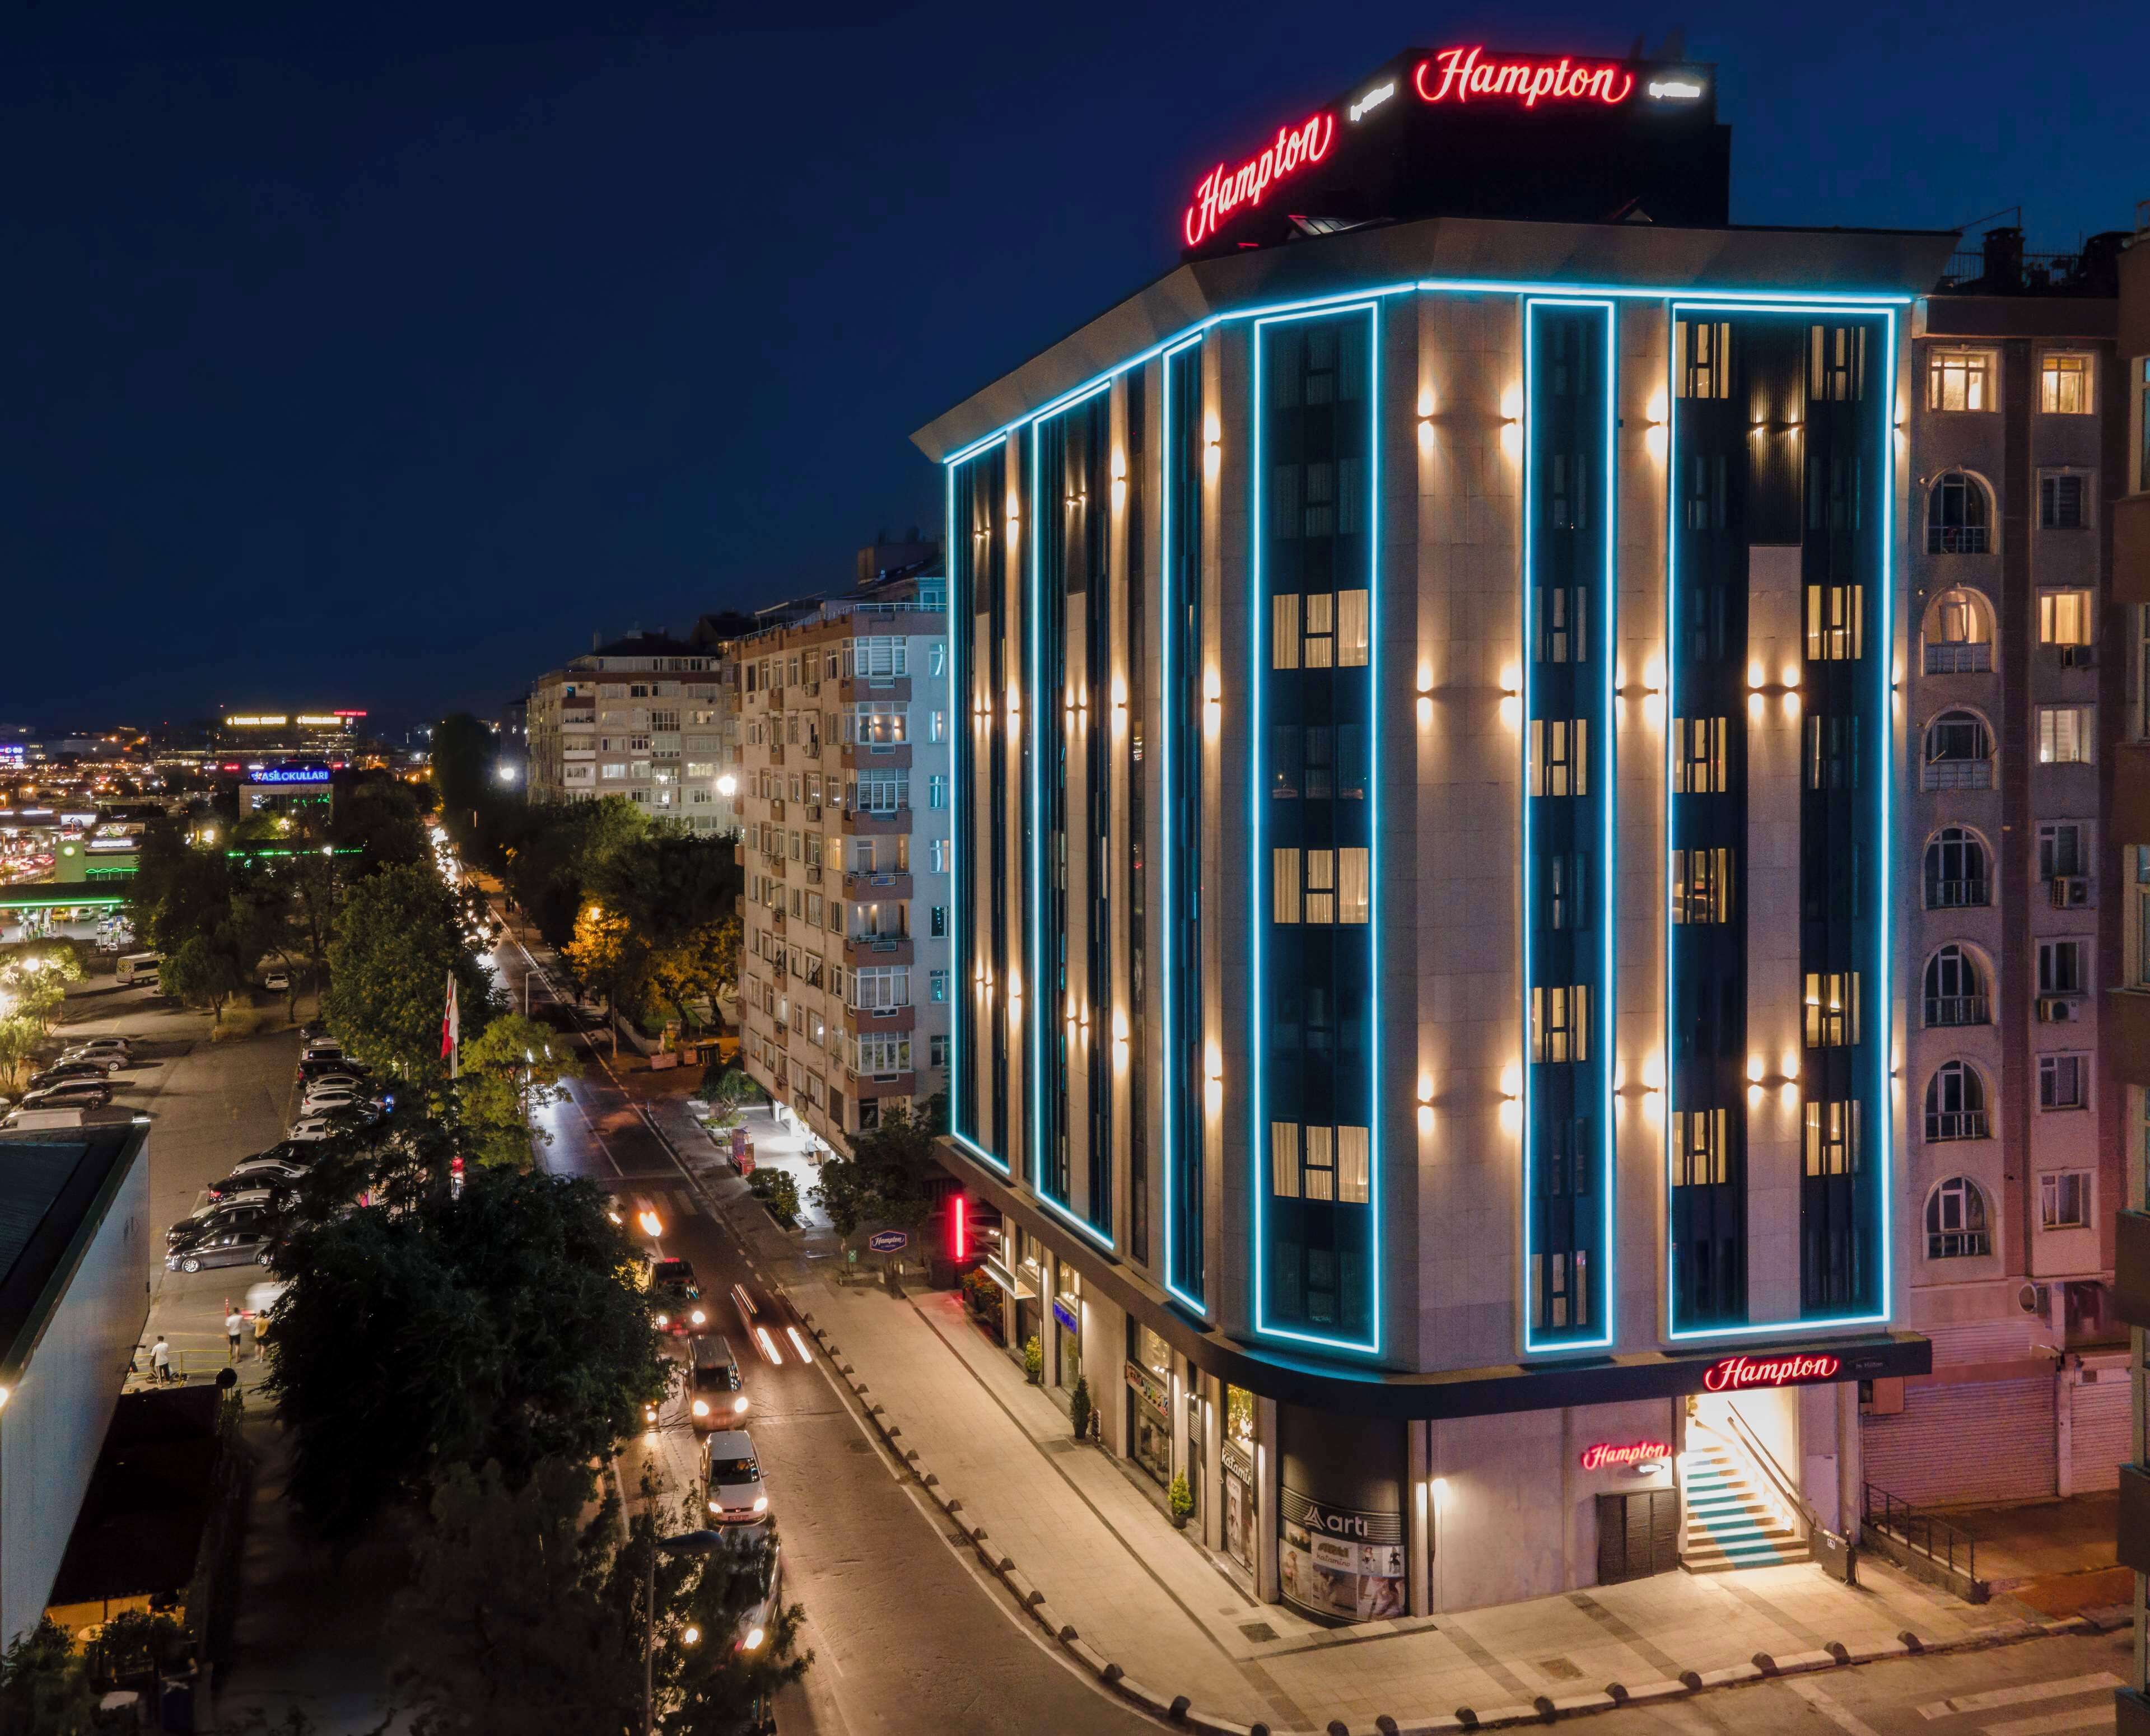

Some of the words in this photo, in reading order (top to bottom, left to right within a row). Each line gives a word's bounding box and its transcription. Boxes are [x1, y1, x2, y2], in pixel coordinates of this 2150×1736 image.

[1416, 46, 1632, 106] Hampton
[1186, 114, 1333, 245] Hampton
[871, 1236, 904, 1246] Hampton
[1705, 1356, 1838, 1391] Hampton
[1583, 1442, 1672, 1471] Hampton
